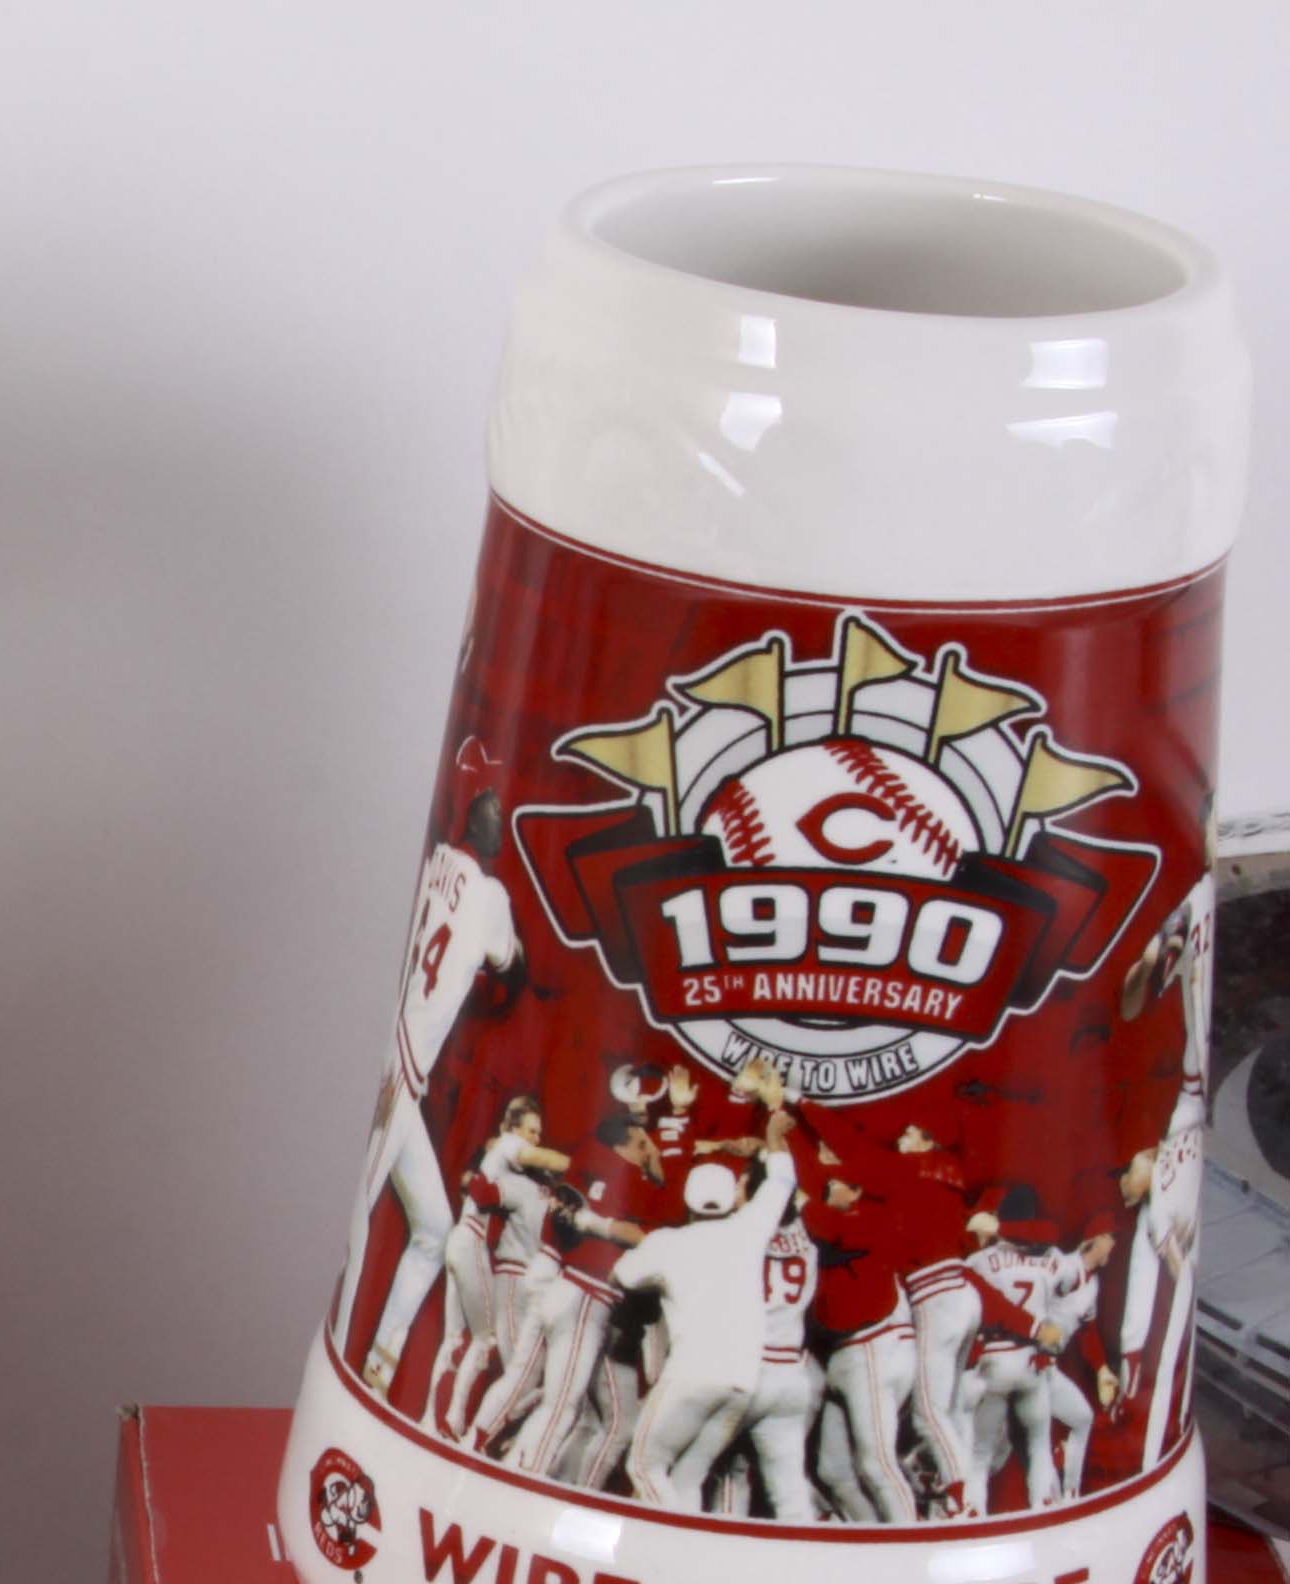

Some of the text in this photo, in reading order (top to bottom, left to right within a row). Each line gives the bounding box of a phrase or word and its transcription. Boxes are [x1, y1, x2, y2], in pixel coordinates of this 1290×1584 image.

[659, 882, 1004, 986] 1990
[752, 971, 963, 1021] ANNIVERSARY
[800, 1058, 839, 1092] TO
[845, 1042, 919, 1093] WIRE
[988, 1251, 1060, 1278] DUNCAN
